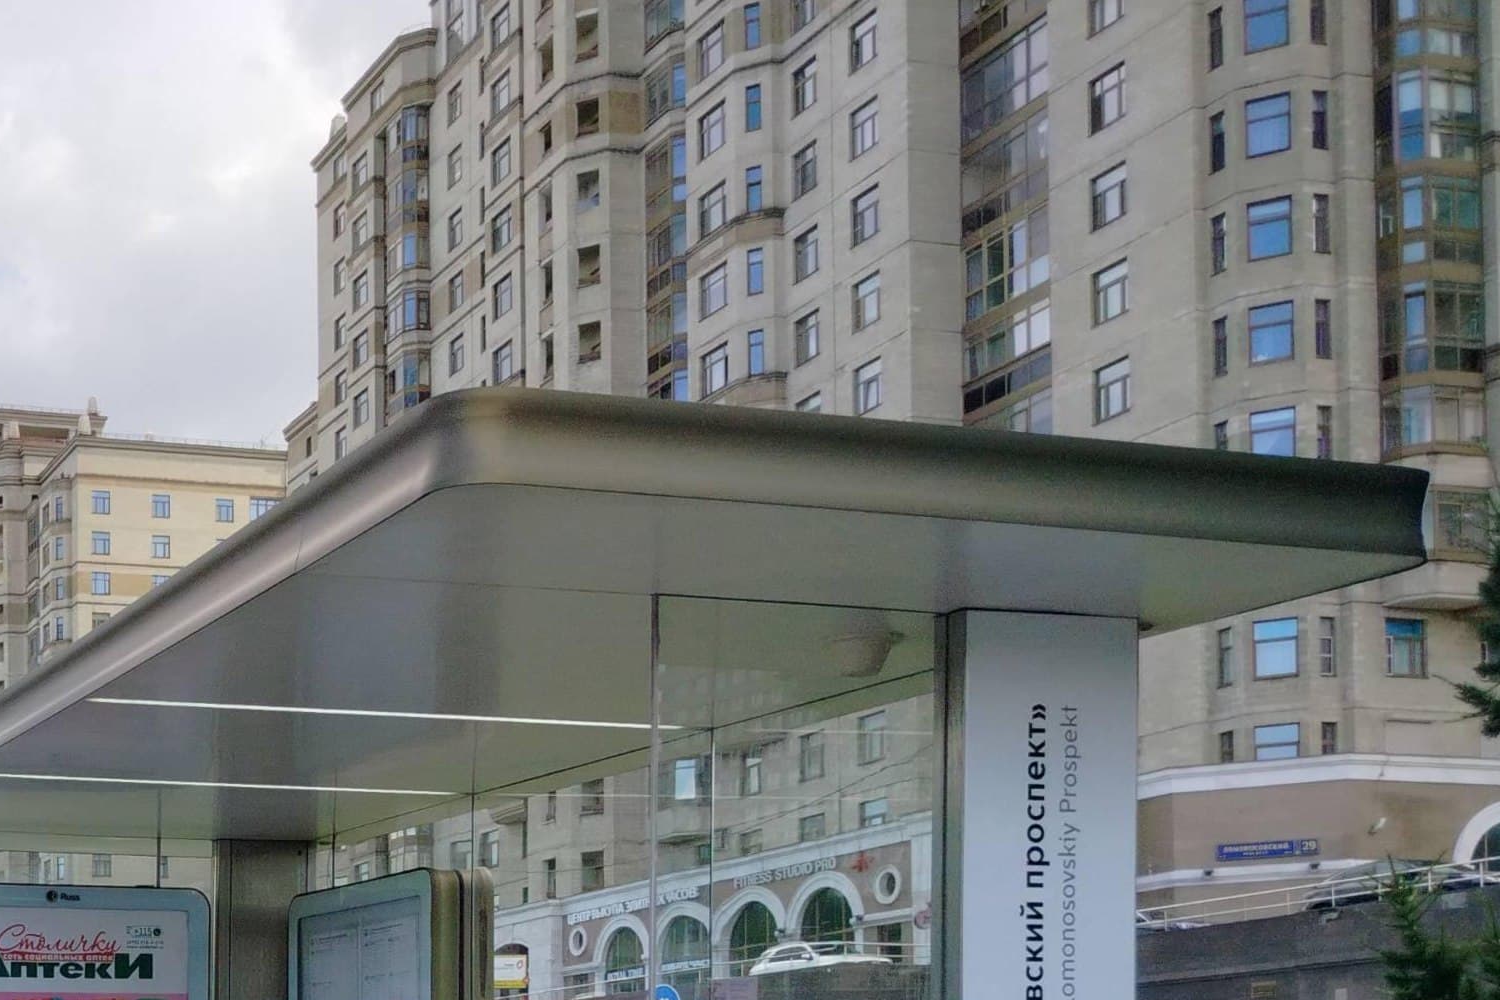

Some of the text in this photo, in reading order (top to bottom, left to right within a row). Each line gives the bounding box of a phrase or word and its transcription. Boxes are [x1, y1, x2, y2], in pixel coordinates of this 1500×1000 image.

[1059, 705, 1082, 813] Prospekt
[1026, 703, 1050, 888] проспект»
[733, 857, 837, 889] FITNESS STUDIO PRO
[1301, 840, 1317, 850] 29
